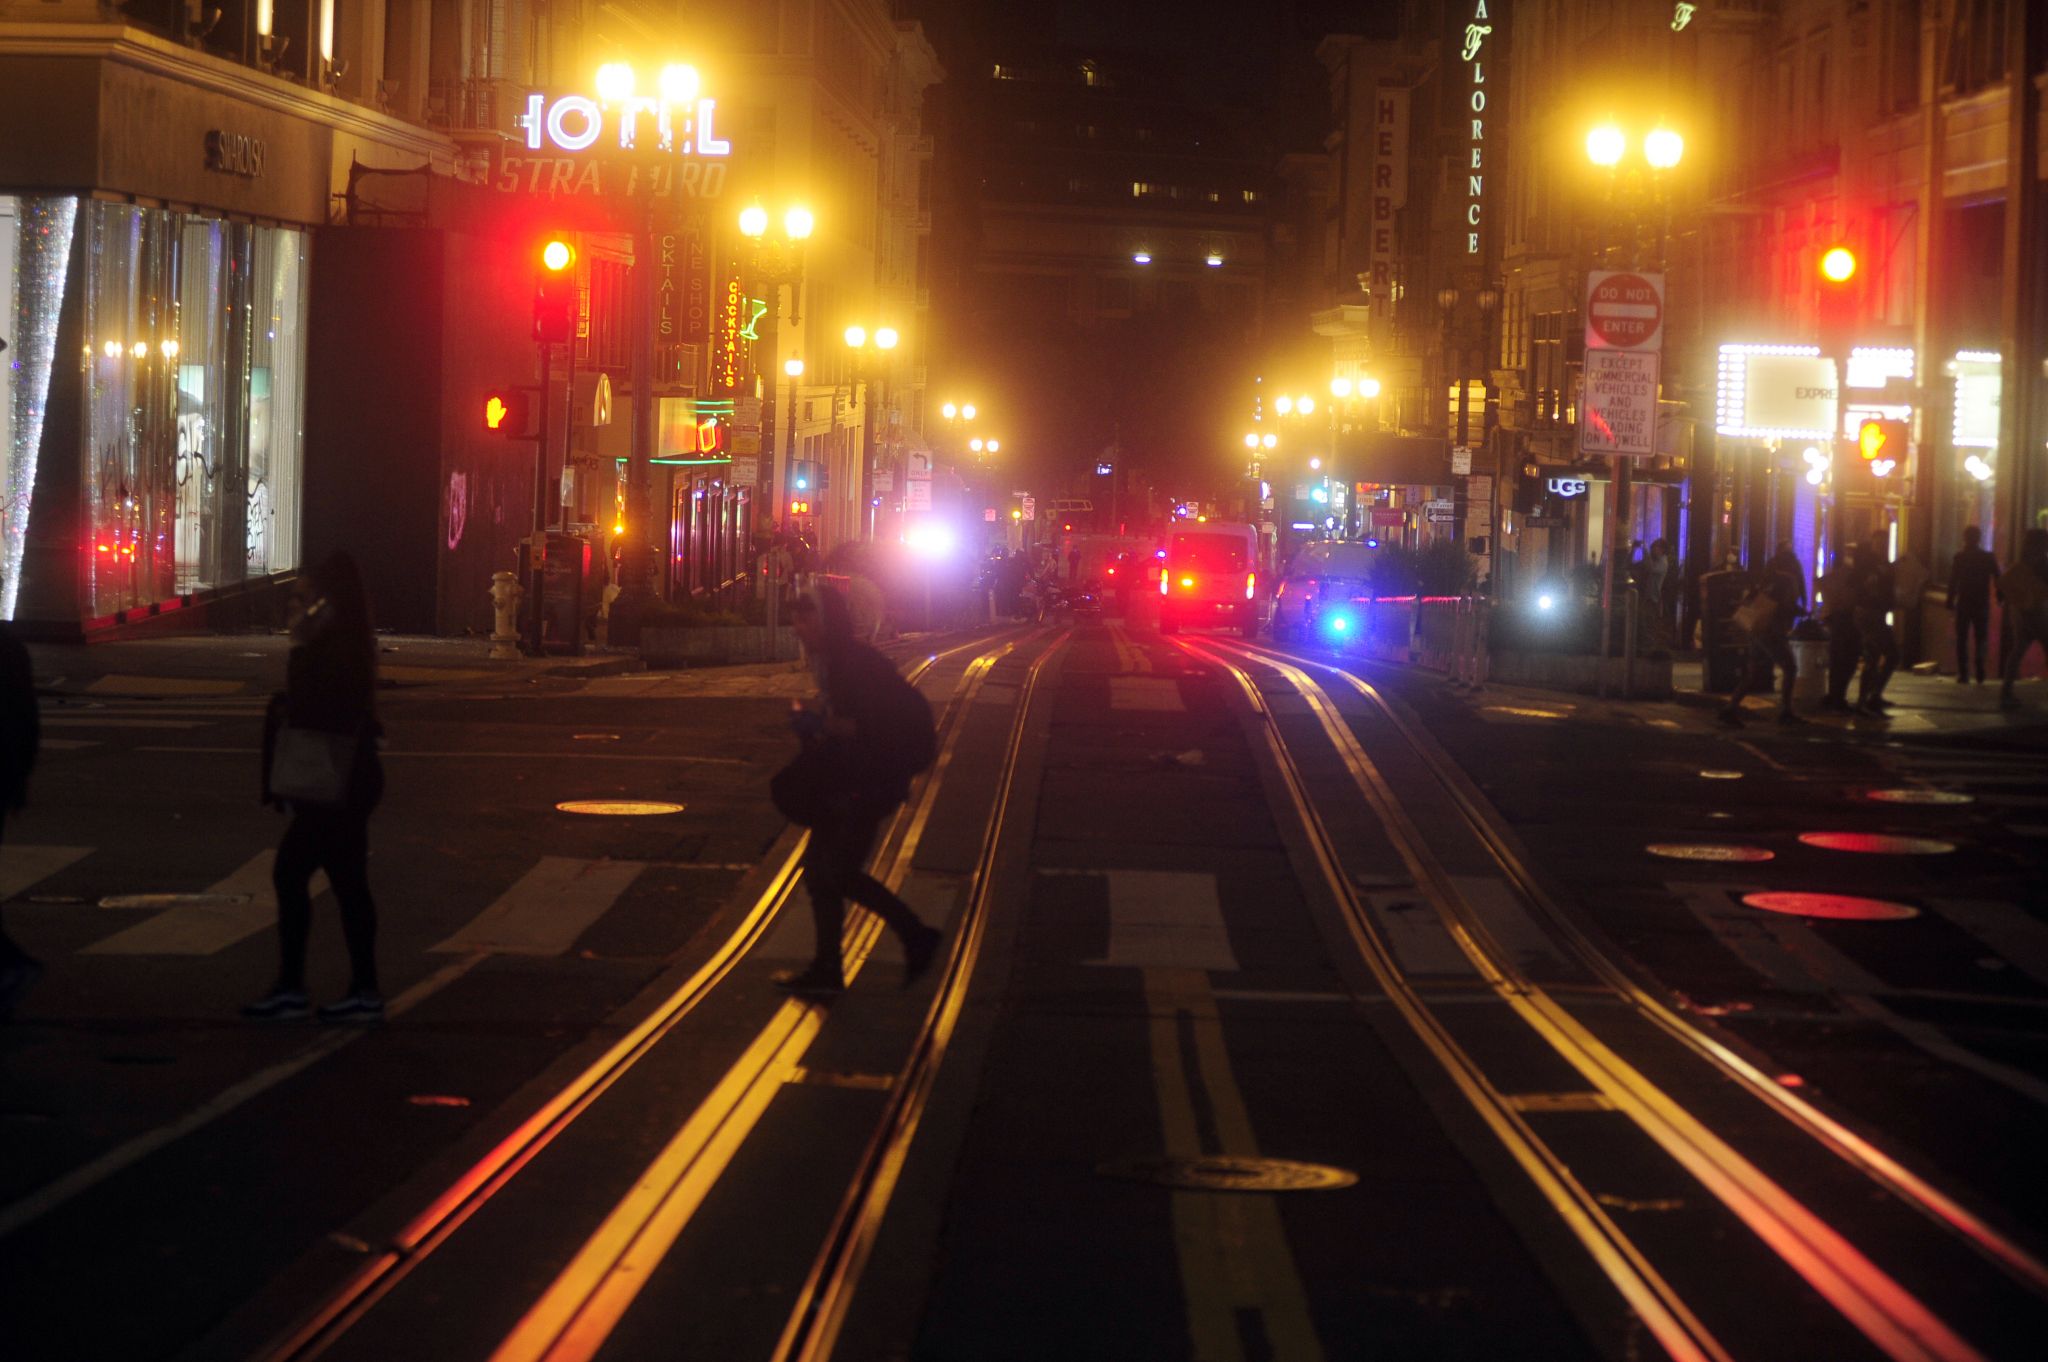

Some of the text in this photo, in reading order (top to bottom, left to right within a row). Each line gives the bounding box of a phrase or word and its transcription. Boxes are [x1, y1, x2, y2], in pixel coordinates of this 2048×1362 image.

[1462, 23, 1492, 254] FLORENCE
[1374, 99, 1395, 318] HERBERT
[1600, 287, 1651, 301] DO NOT
[1603, 320, 1645, 334] ENTER
[725, 281, 739, 388] COCKTAILS
[1601, 358, 1643, 370] EXCEPT
[1588, 369, 1653, 384] COMMERCIAL
[1594, 382, 1648, 396] VEHICLES
[1609, 397, 1632, 408] AND
[1593, 408, 1647, 423] VEHICLES
[1585, 433, 1600, 445] ON
[1548, 478, 1586, 497] UGG
